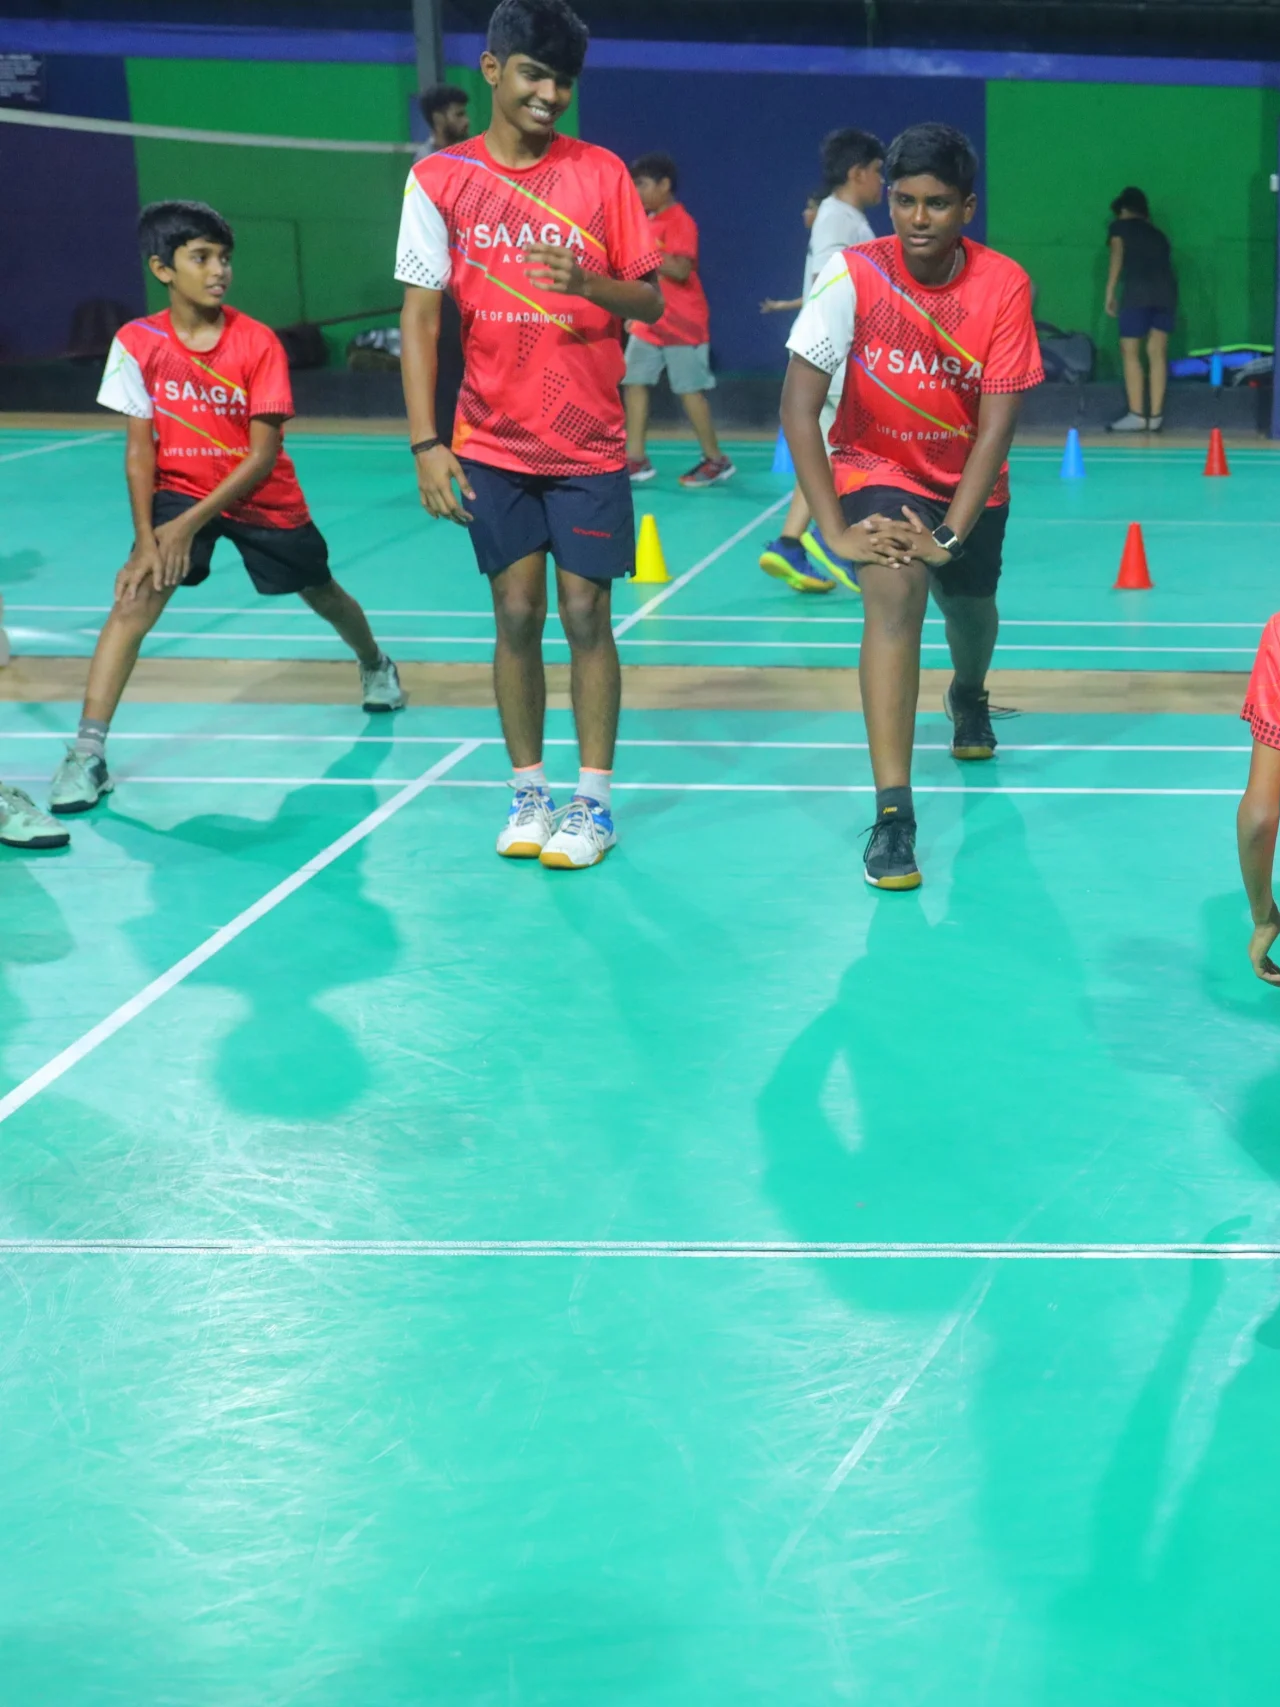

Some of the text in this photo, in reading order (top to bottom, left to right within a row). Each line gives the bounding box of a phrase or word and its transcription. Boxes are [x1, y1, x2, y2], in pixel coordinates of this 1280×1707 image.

[473, 223, 585, 249] SAAGA
[490, 311, 503, 321] OF
[900, 431, 914, 441] OF
